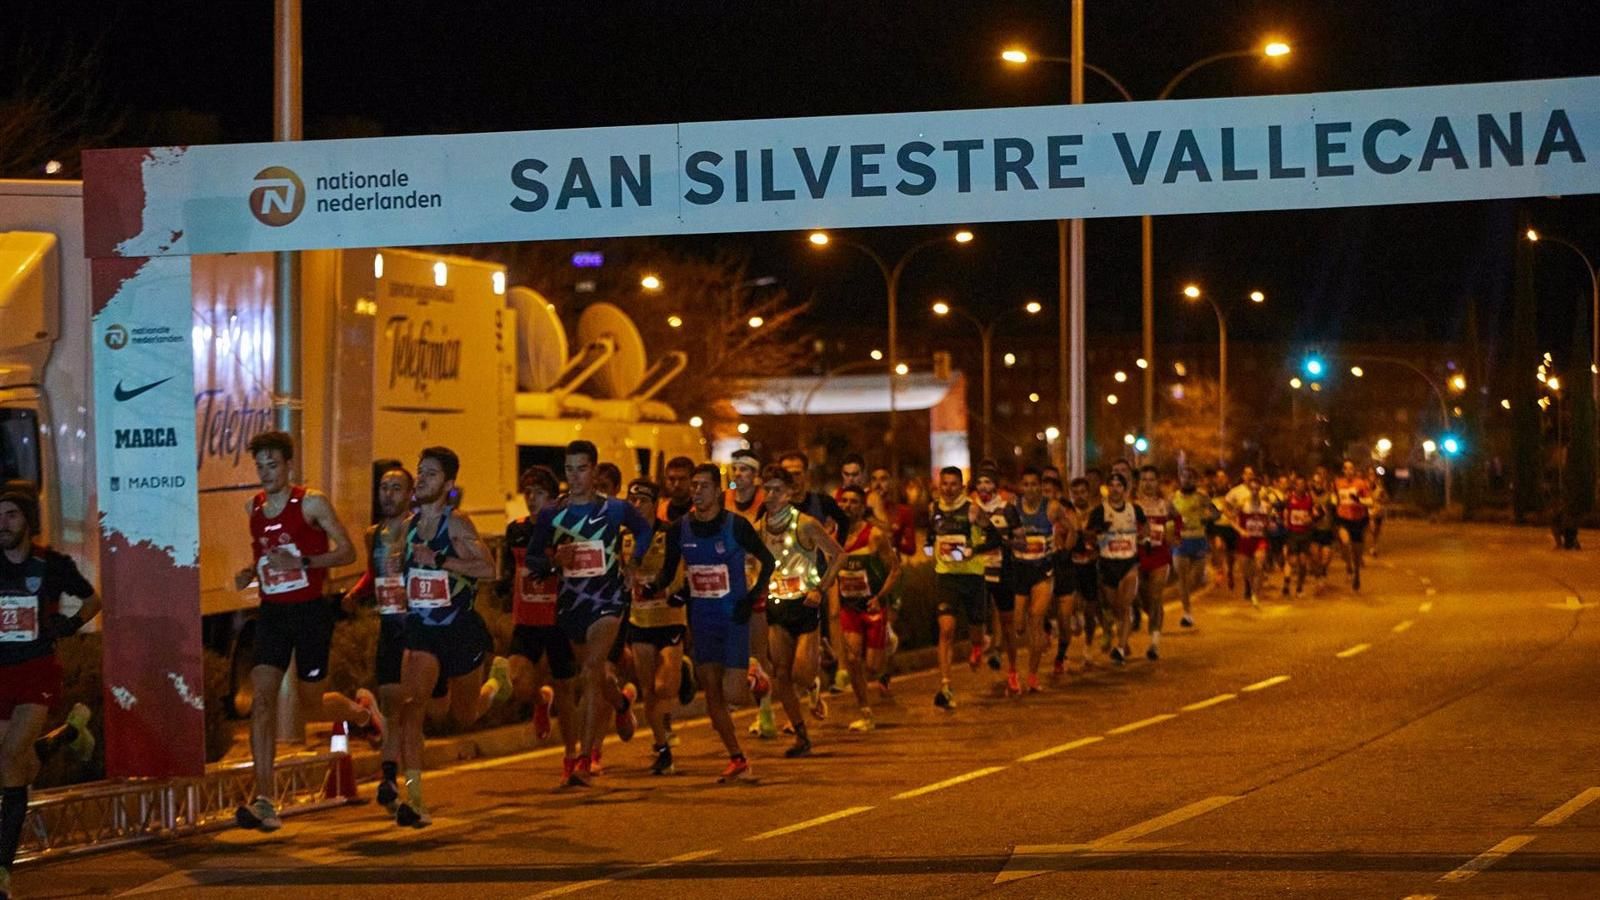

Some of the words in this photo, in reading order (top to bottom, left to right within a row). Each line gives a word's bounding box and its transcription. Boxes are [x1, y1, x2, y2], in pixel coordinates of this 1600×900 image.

[510, 154, 652, 213] SAN
[684, 135, 1086, 206] SILVESTRE
[1112, 109, 1587, 186] VALLECANA
[316, 169, 409, 190] nationale
[317, 190, 442, 212] nederlanden
[131, 326, 170, 335] nationale
[131, 335, 184, 344] nederlanden
[115, 428, 177, 449] MARCA
[128, 476, 185, 489] MADRID
[419, 580, 432, 594] 97
[2, 610, 17, 625] 23
